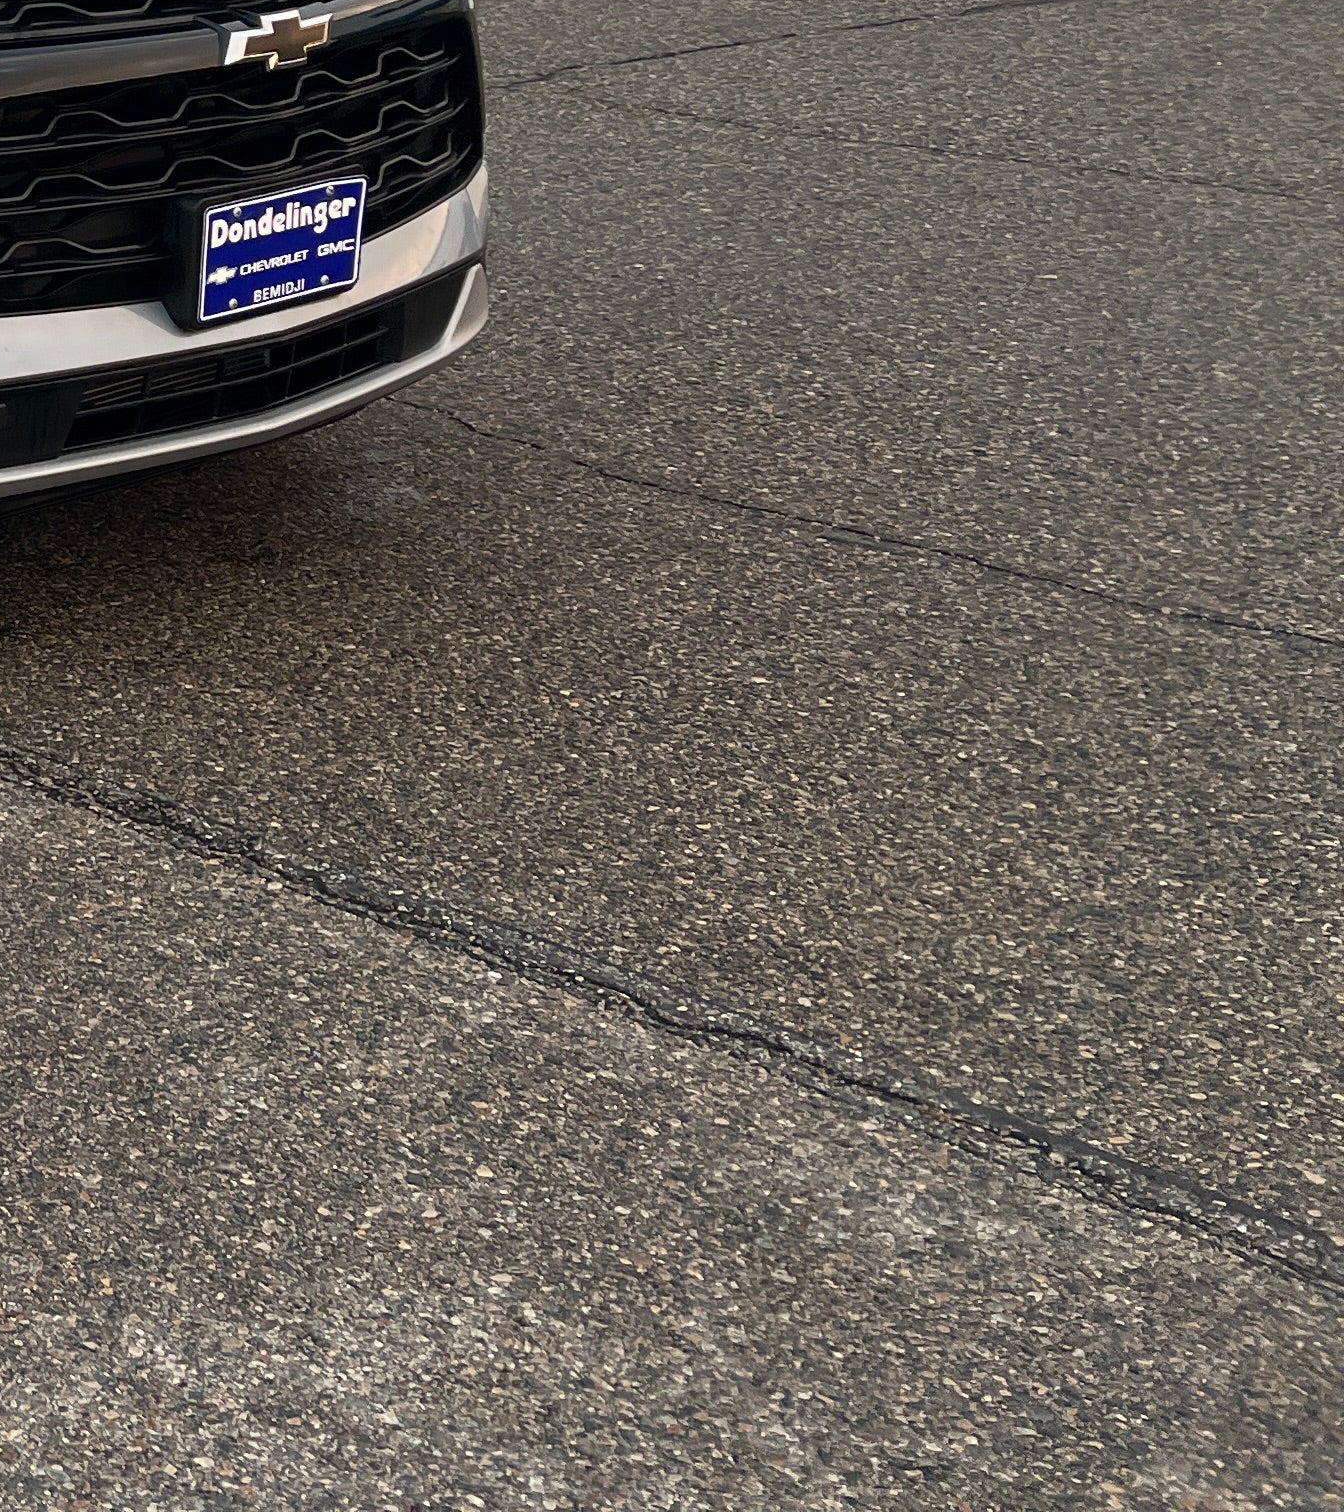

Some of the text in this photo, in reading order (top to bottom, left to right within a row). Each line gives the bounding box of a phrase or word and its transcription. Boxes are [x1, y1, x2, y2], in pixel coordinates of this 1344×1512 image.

[211, 197, 356, 248] Dondelinger
[240, 238, 355, 276] CHEVROLET GMC
[253, 278, 306, 303] BEMIDJI
